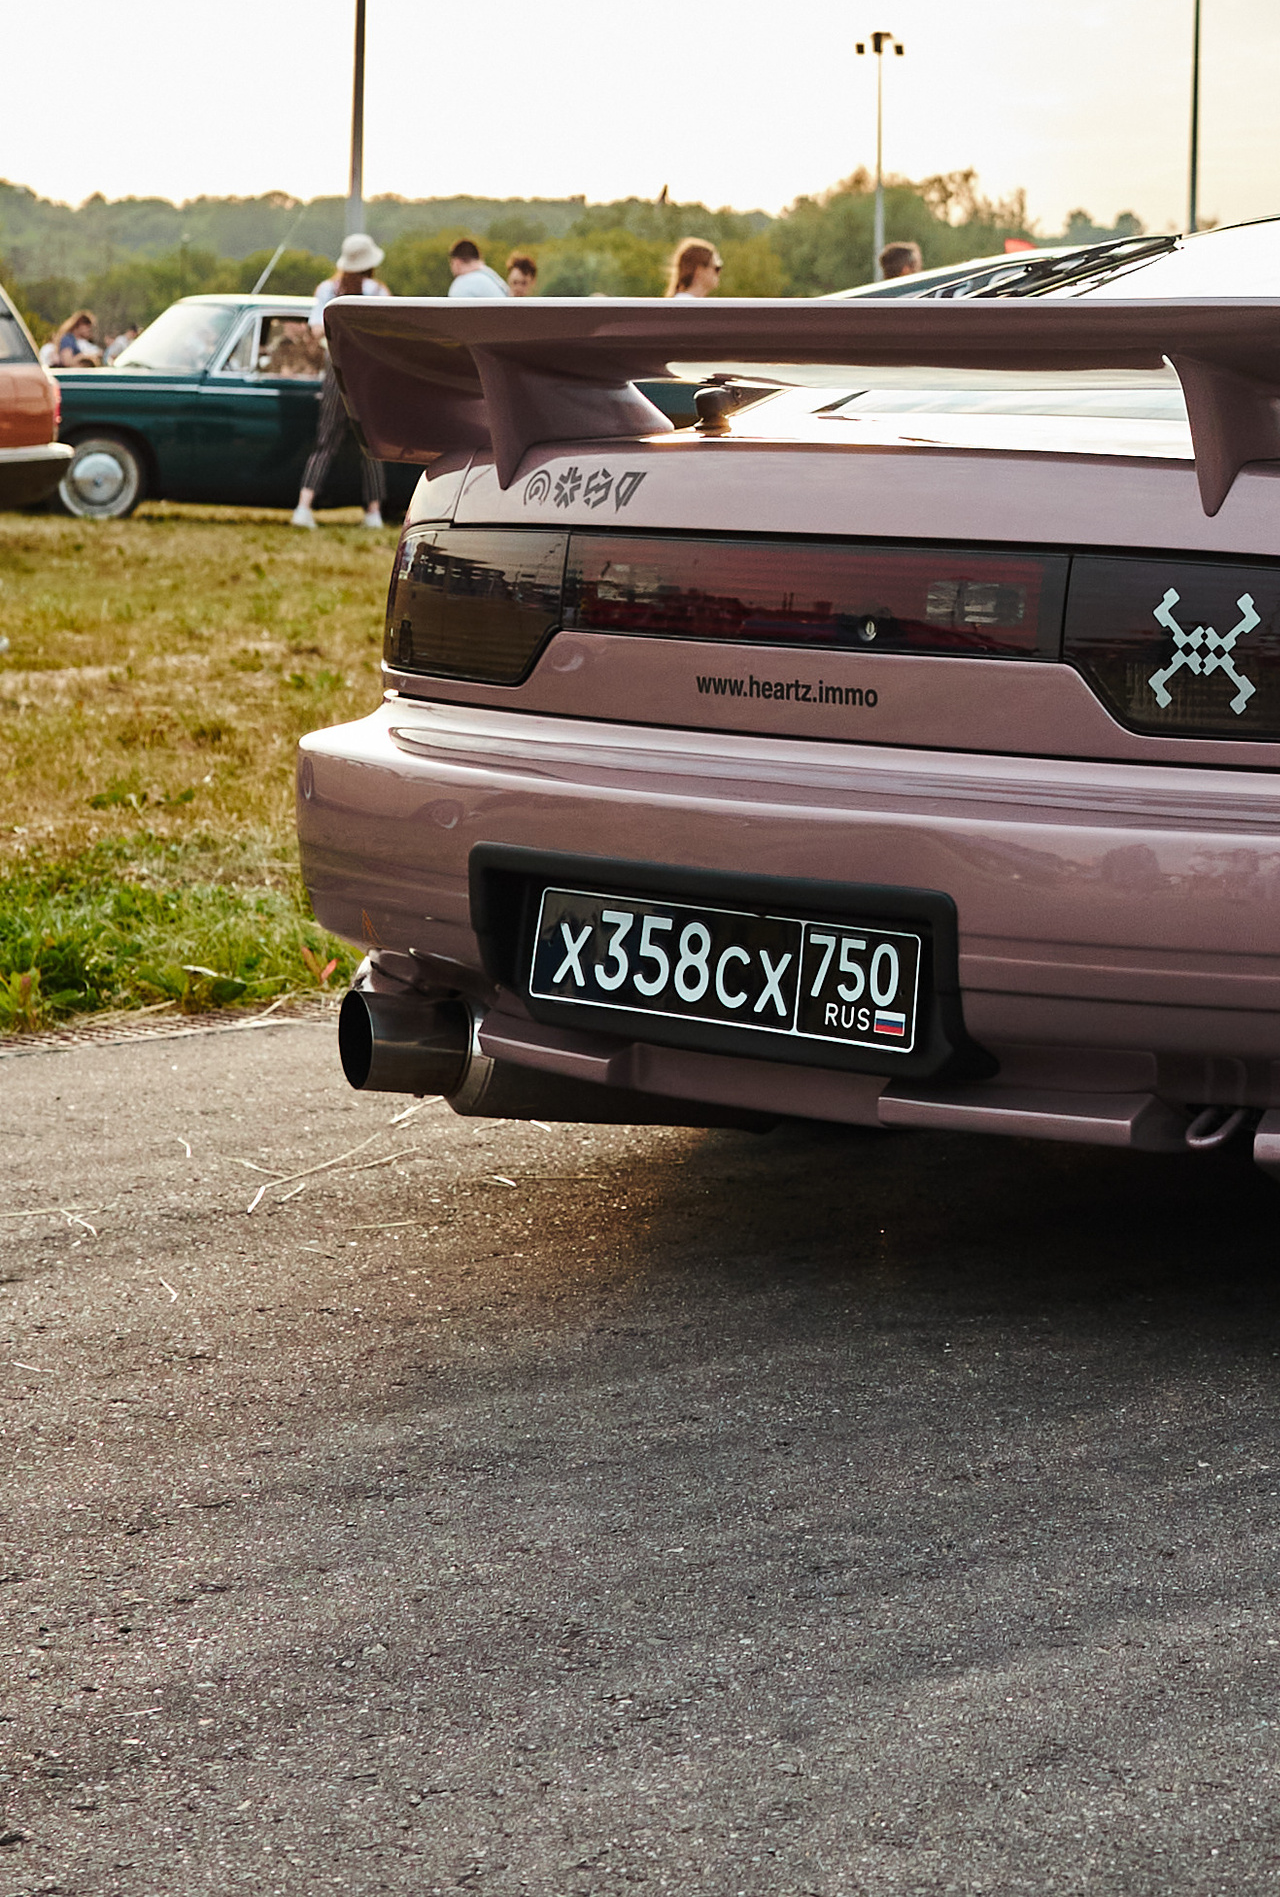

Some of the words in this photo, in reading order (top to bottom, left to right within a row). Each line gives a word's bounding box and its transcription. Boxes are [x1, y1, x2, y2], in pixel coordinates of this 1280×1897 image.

[696, 674, 879, 708] www.heartz.immo
[809, 933, 900, 1008] 750
[824, 1002, 871, 1032] RUS
